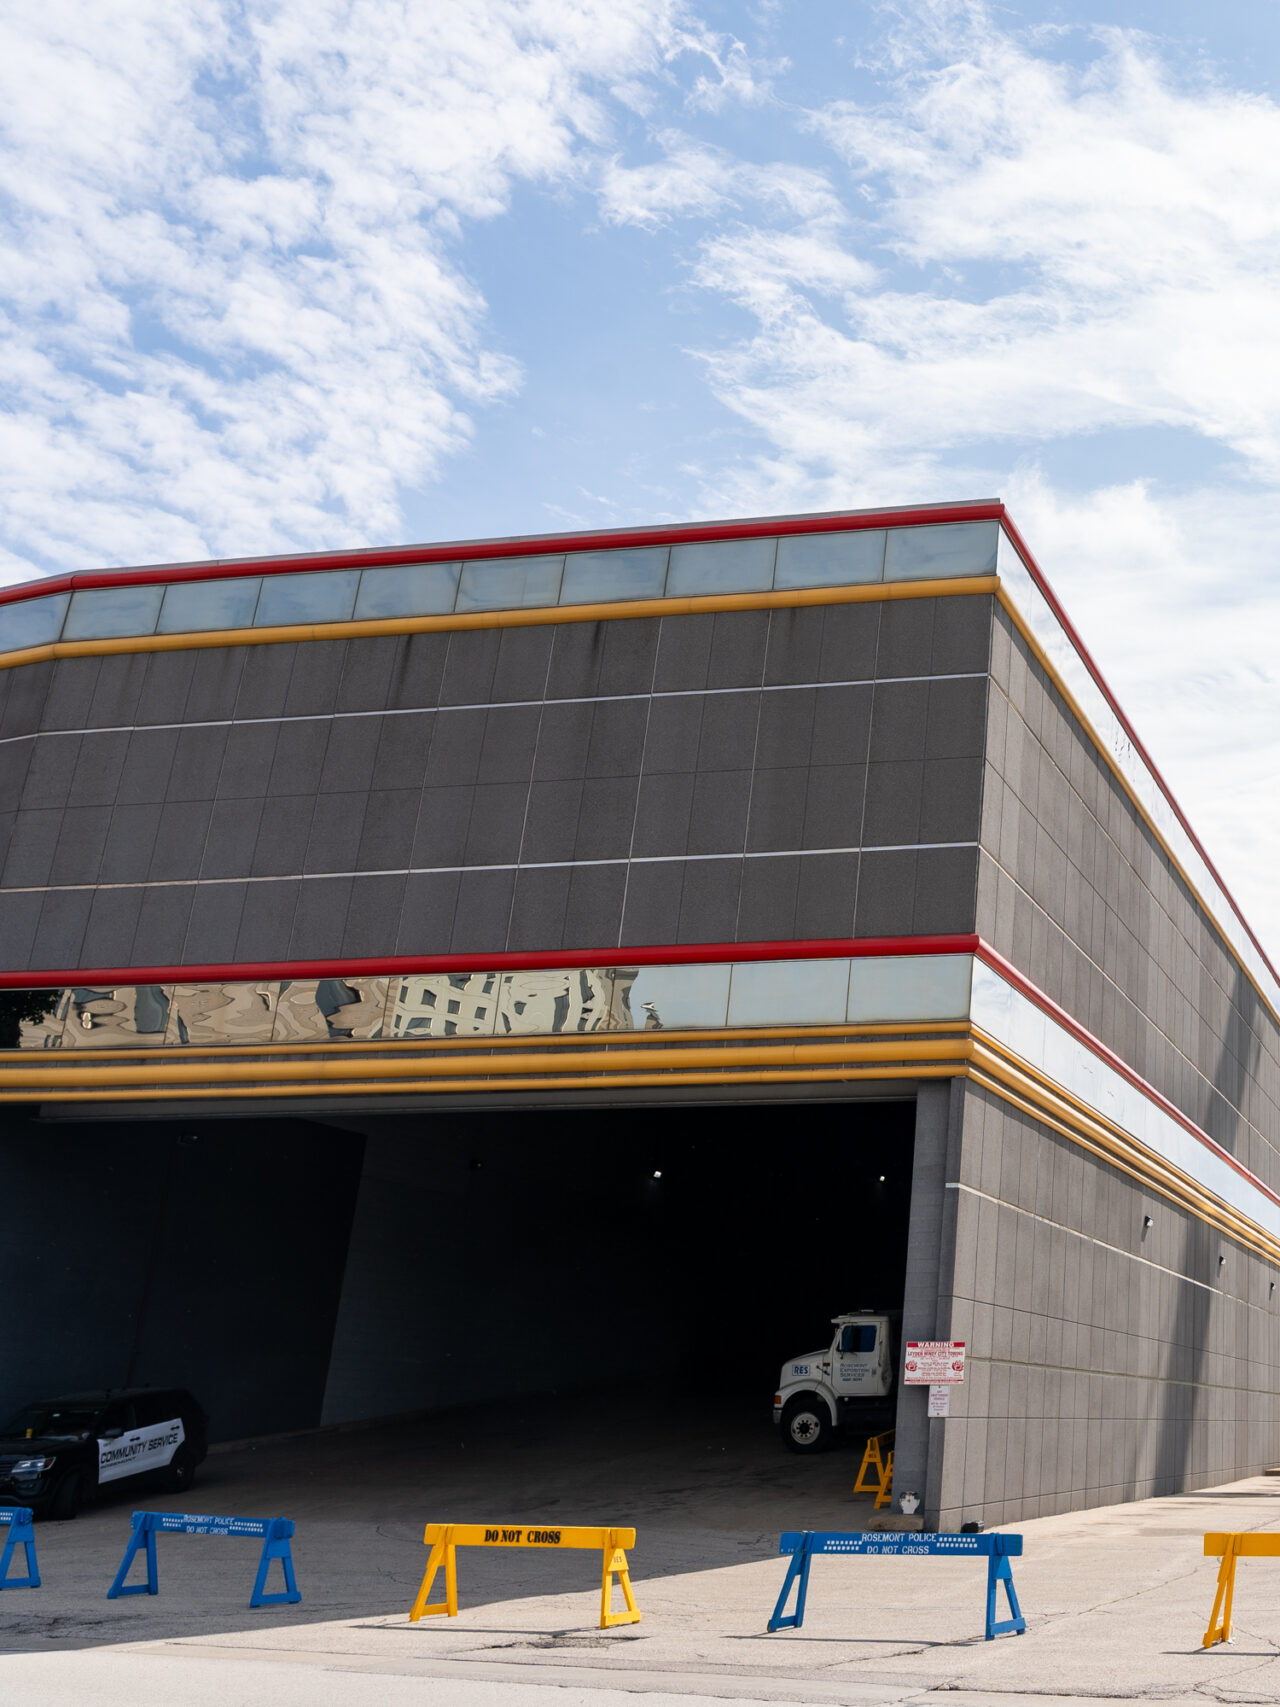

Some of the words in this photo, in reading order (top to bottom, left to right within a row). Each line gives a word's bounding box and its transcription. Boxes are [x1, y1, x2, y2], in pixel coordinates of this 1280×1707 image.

[794, 1366, 809, 1374] RES
[100, 1441, 147, 1464] COMMUNITY
[148, 1433, 178, 1451] SERVICE
[183, 1514, 213, 1524] ROSEMONT
[214, 1517, 235, 1526] POLICE
[186, 1525, 195, 1534] DO
[196, 1526, 208, 1535] NOT
[209, 1527, 229, 1536] CROSS
[484, 1529, 499, 1542] DO
[500, 1529, 522, 1543] NOT
[526, 1530, 561, 1544] CROSS
[861, 1533, 904, 1542] ROSEMONT
[908, 1533, 937, 1543] POLICE
[866, 1545, 879, 1554] DO
[881, 1545, 899, 1554] NOT
[901, 1545, 930, 1555] CROSS
